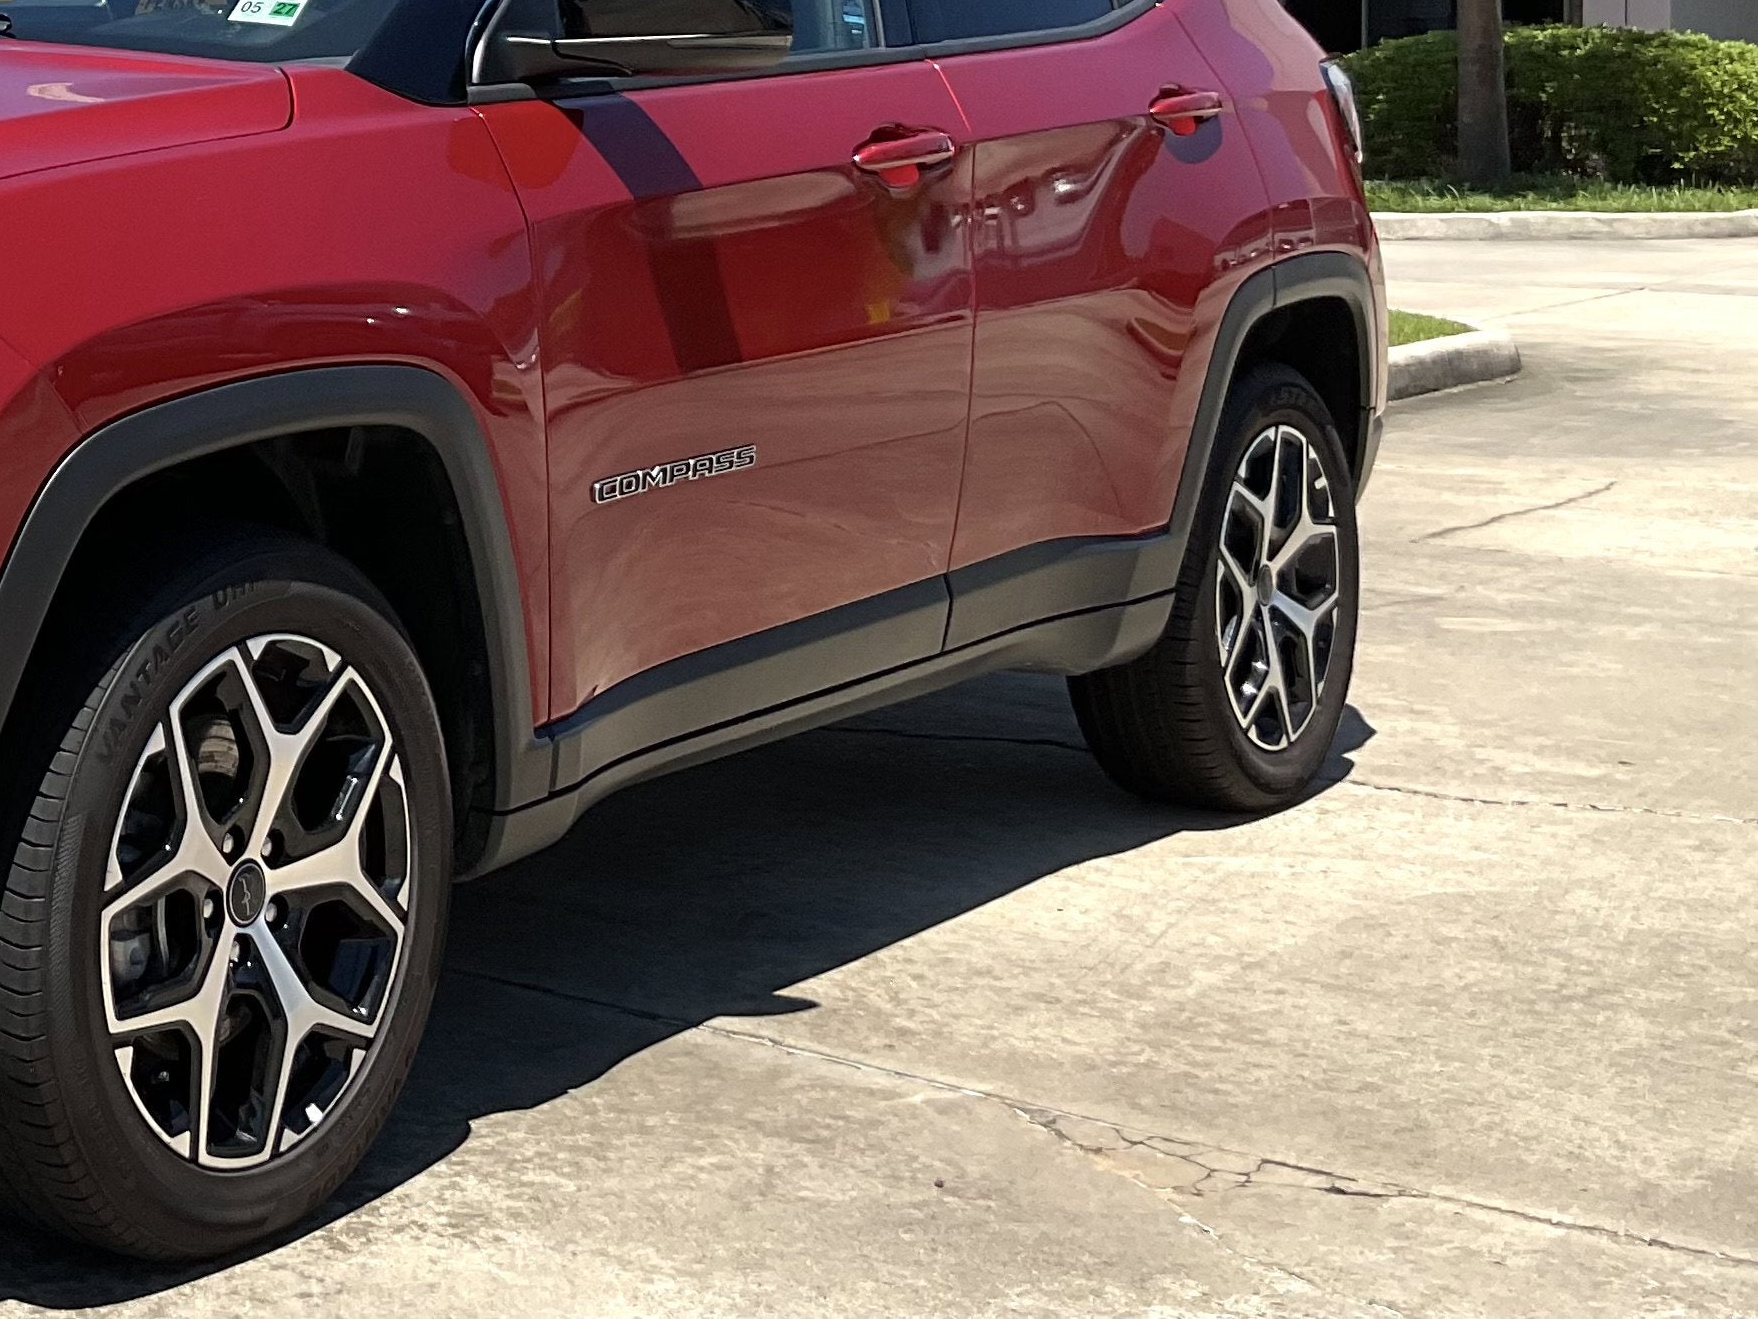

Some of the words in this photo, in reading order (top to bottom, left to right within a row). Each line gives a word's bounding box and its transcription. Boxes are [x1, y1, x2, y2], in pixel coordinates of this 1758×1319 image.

[241, 1, 264, 13] 05
[273, 2, 298, 15] 27
[591, 444, 757, 504] COMPASS
